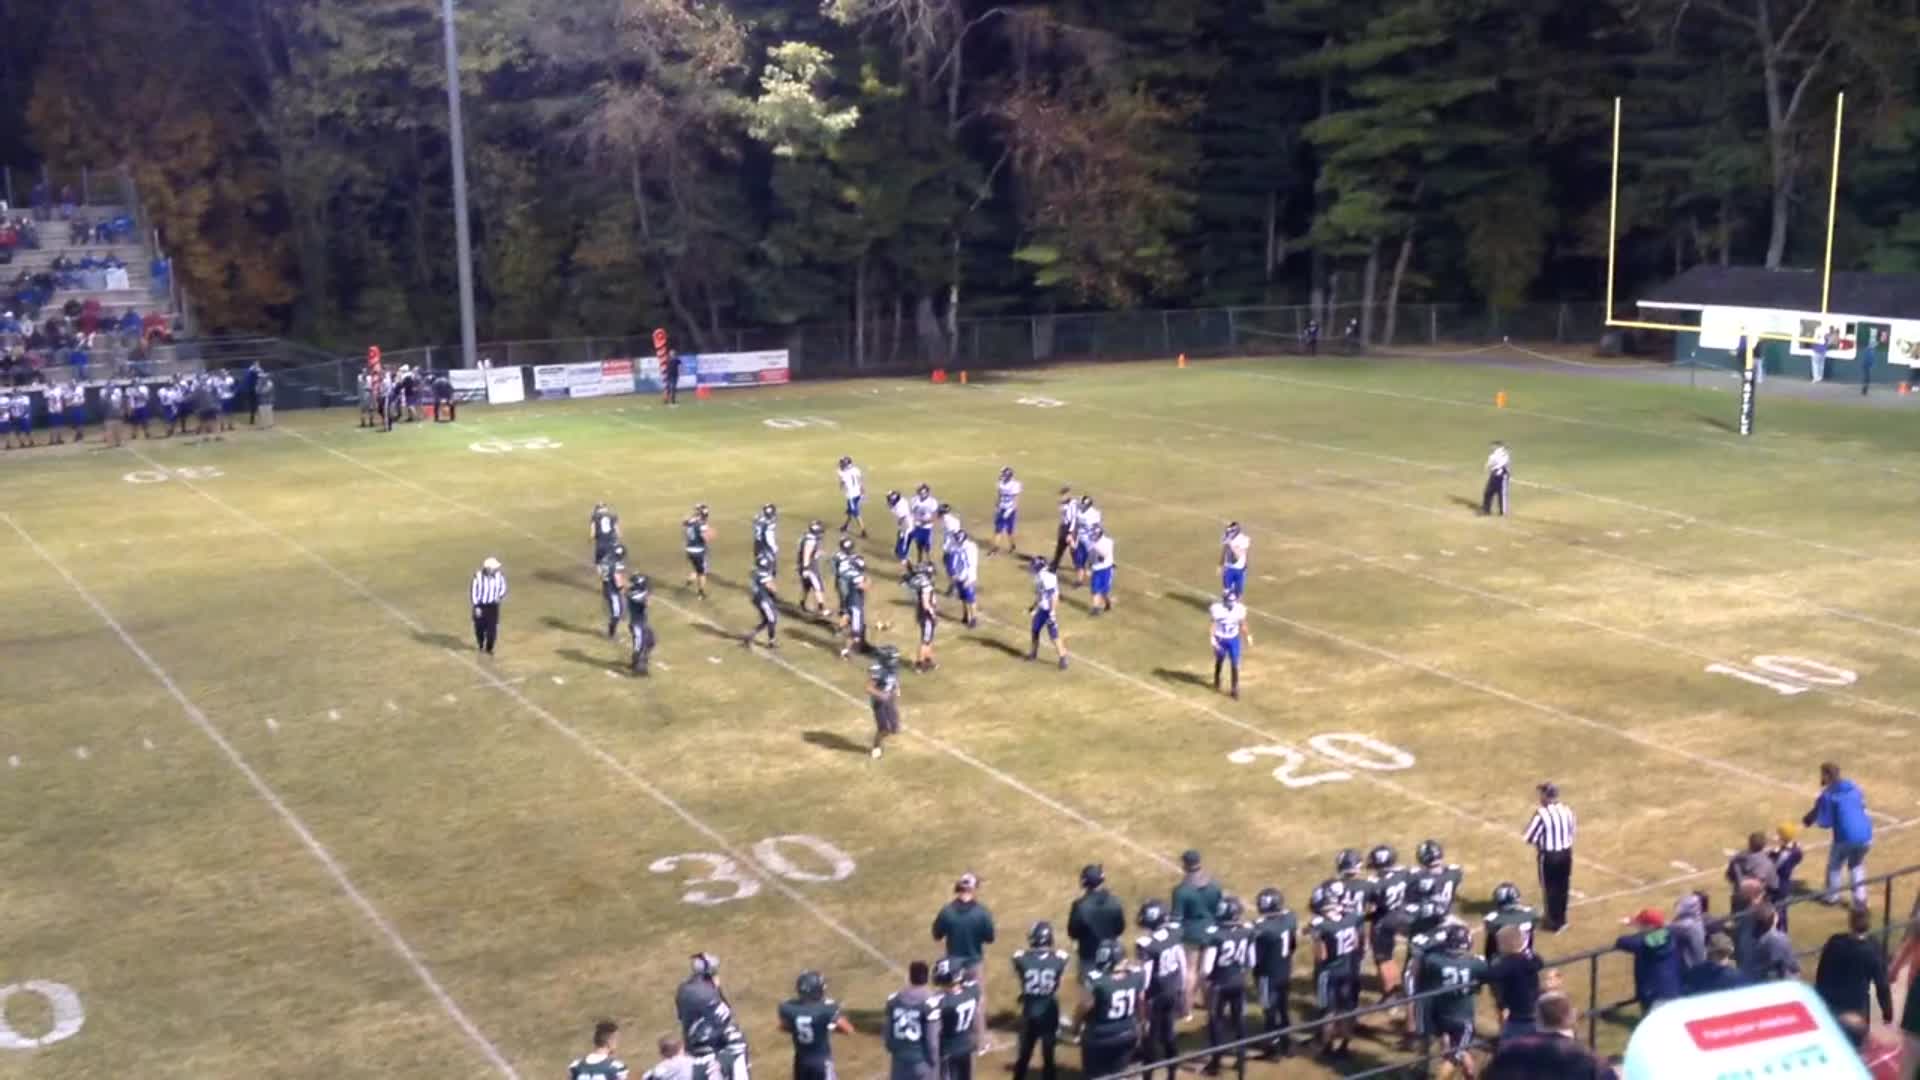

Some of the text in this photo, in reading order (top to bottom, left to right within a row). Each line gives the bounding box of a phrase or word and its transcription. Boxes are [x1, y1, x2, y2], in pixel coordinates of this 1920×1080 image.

[1704, 656, 1857, 694] 10
[1228, 732, 1416, 789] 20
[649, 834, 857, 906] 30
[1218, 938, 1248, 968] 24
[1335, 927, 1358, 956] 12
[955, 998, 977, 1032] 17
[1108, 987, 1136, 1020] 51
[795, 1017, 815, 1045] 5
[893, 1007, 922, 1042] 25
